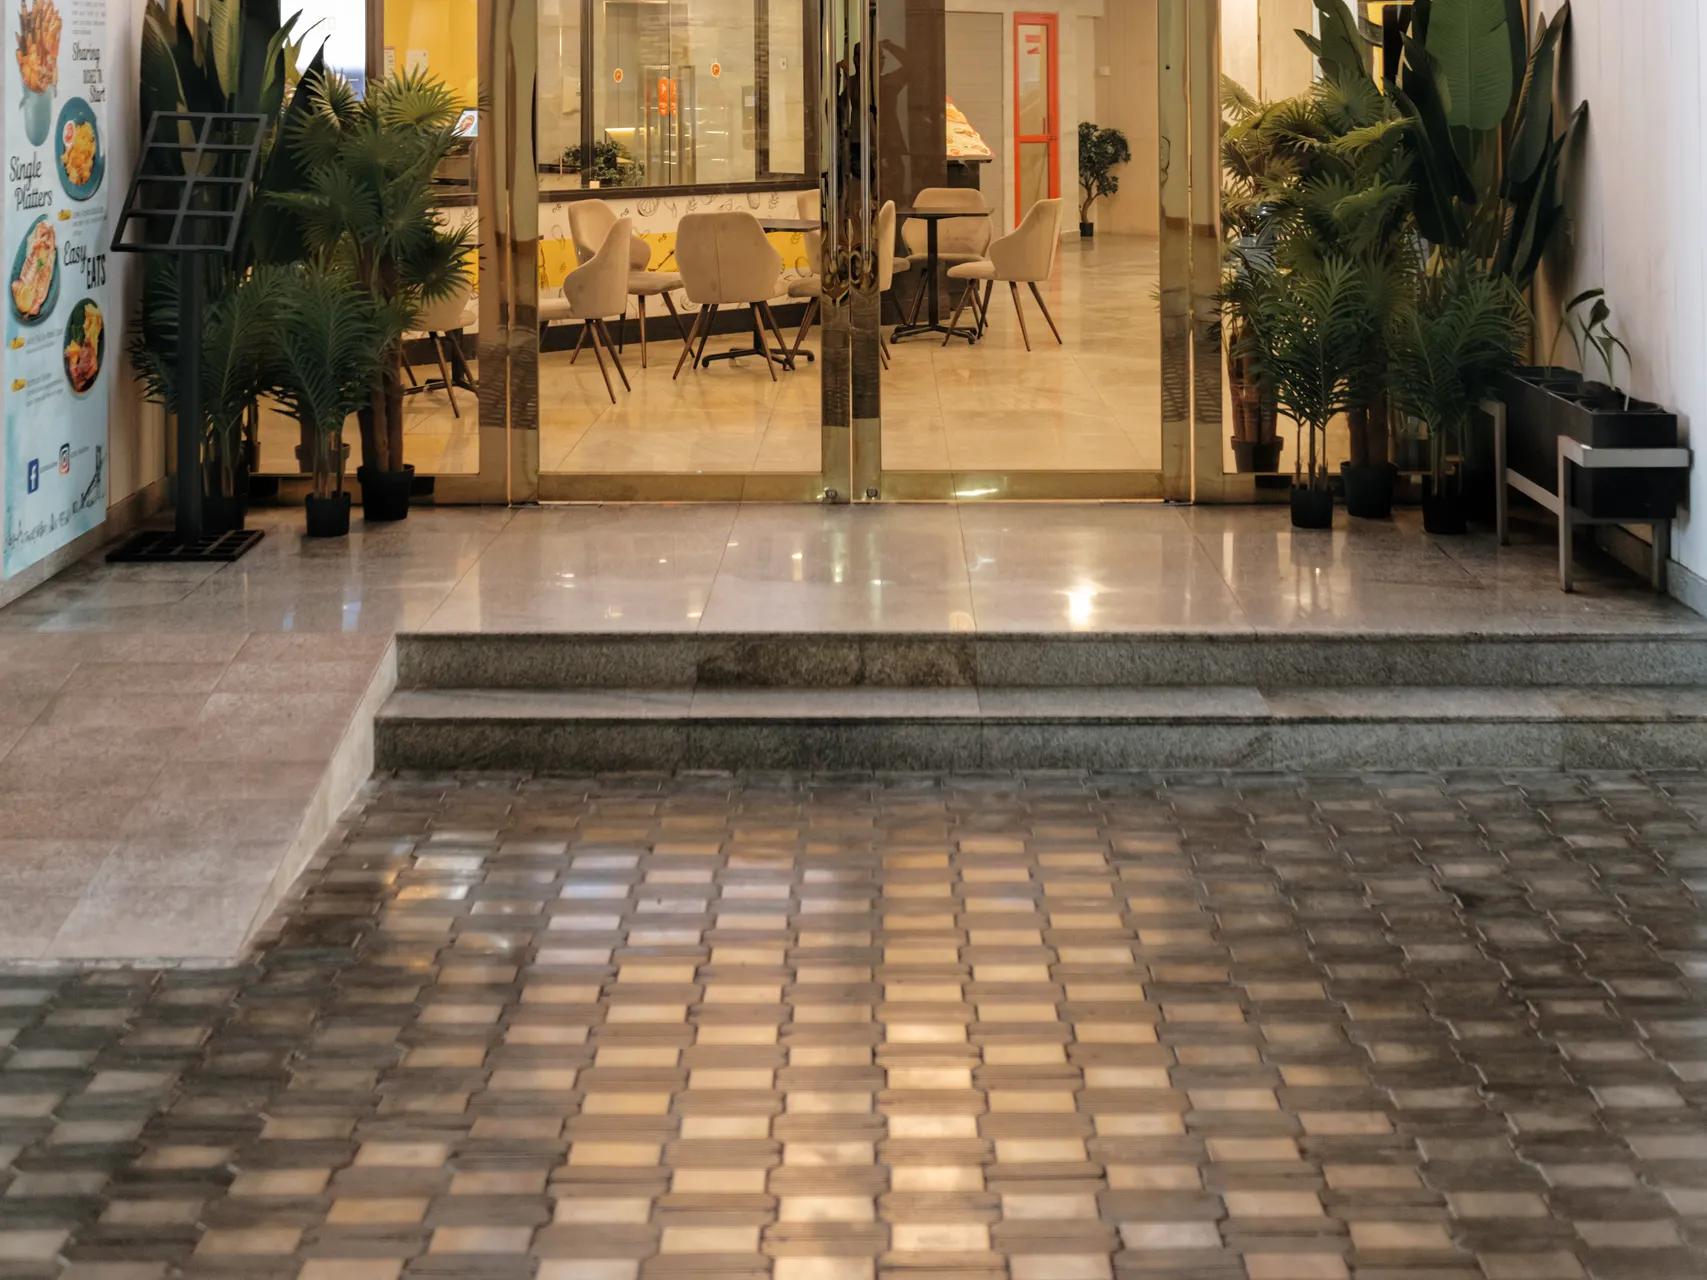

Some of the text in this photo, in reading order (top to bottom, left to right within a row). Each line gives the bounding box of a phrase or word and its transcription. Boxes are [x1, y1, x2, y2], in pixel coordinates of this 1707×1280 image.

[9, 151, 42, 191] Single
[15, 186, 53, 212] Platters
[64, 240, 87, 273] Easy
[86, 253, 106, 290] EATS
